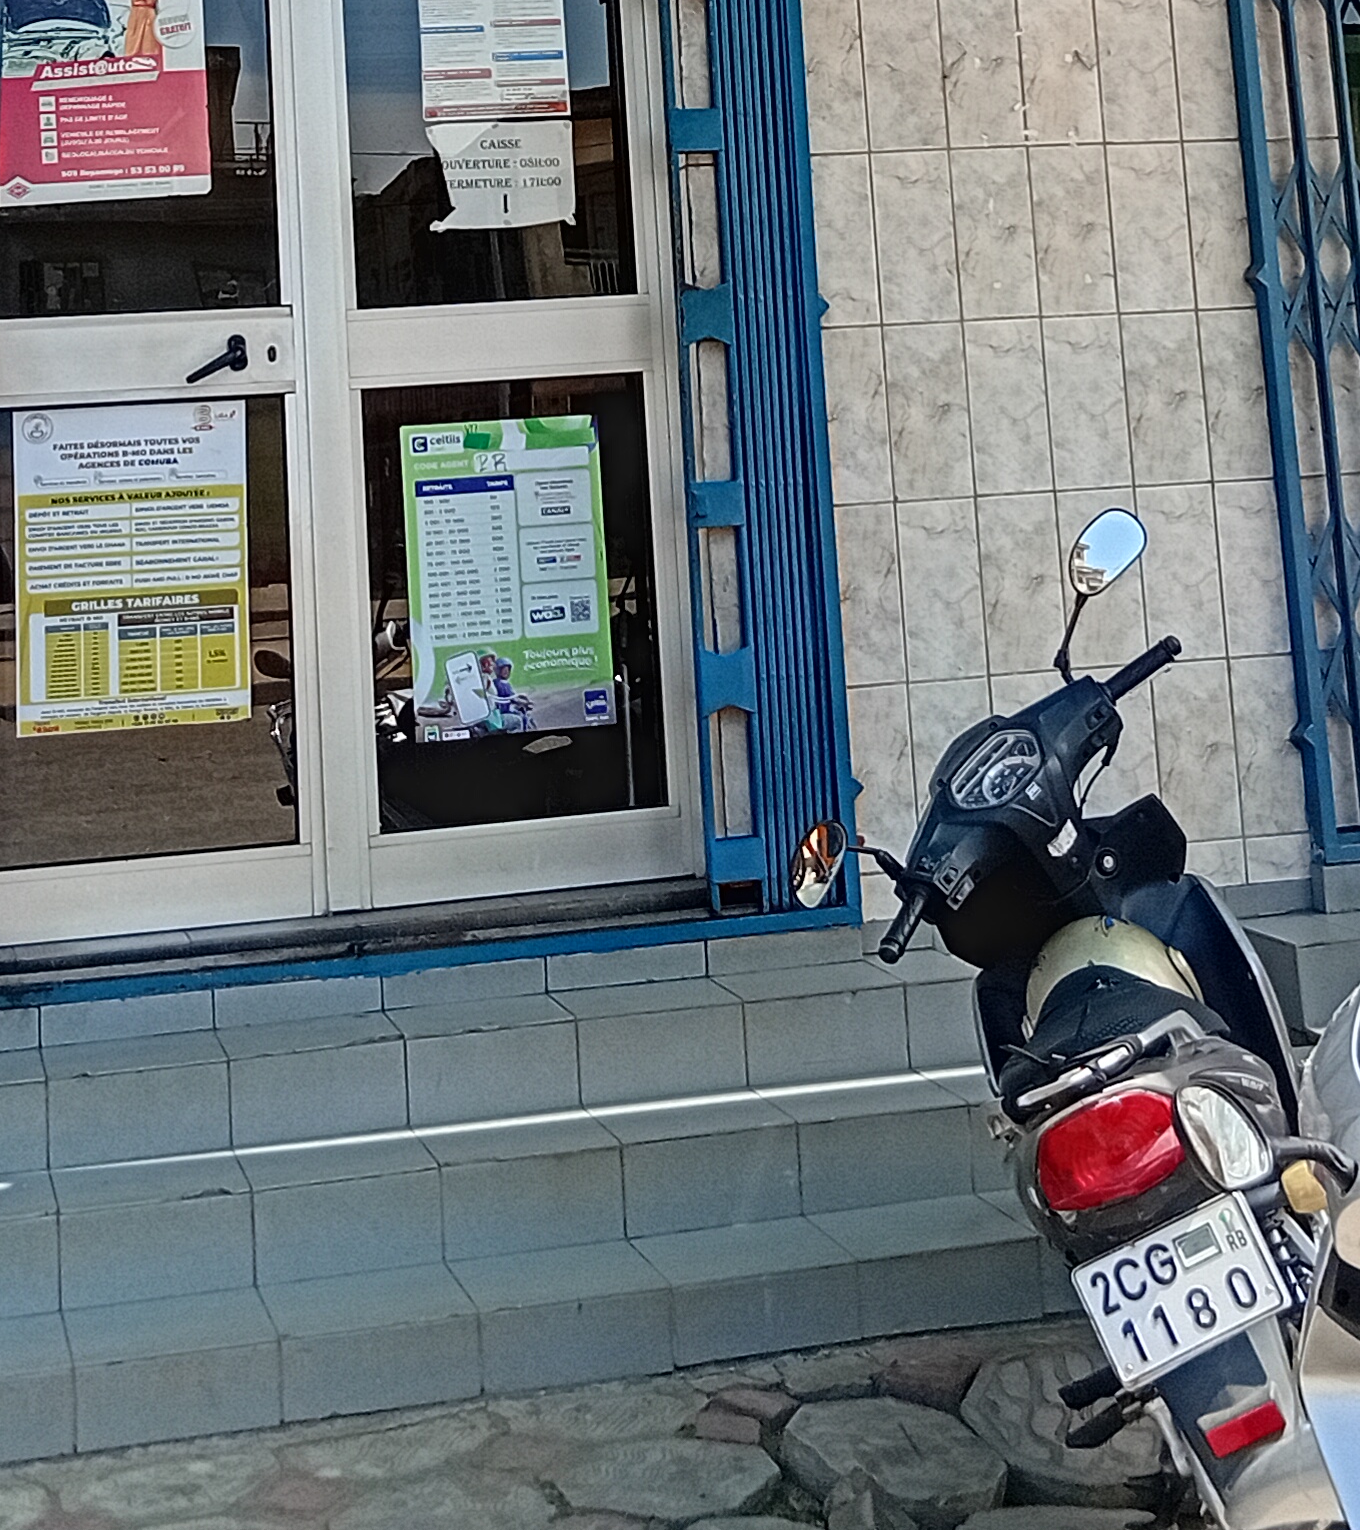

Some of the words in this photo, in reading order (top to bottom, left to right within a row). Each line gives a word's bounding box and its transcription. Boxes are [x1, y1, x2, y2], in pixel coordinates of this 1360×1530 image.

[40, 58, 135, 80] Assist@uto
[480, 139, 522, 150] CAISSE
[442, 158, 511, 170] OUVERTURE
[144, 437, 179, 448] TOUTES
[51, 496, 71, 505] NOS
[71, 599, 123, 612] GRILLES
[126, 593, 200, 608] TARIFAIRES
[1089, 1242, 1178, 1317] 2CG
[1225, 1228, 1248, 1253] RB
[1121, 1266, 1258, 1362] 1180
